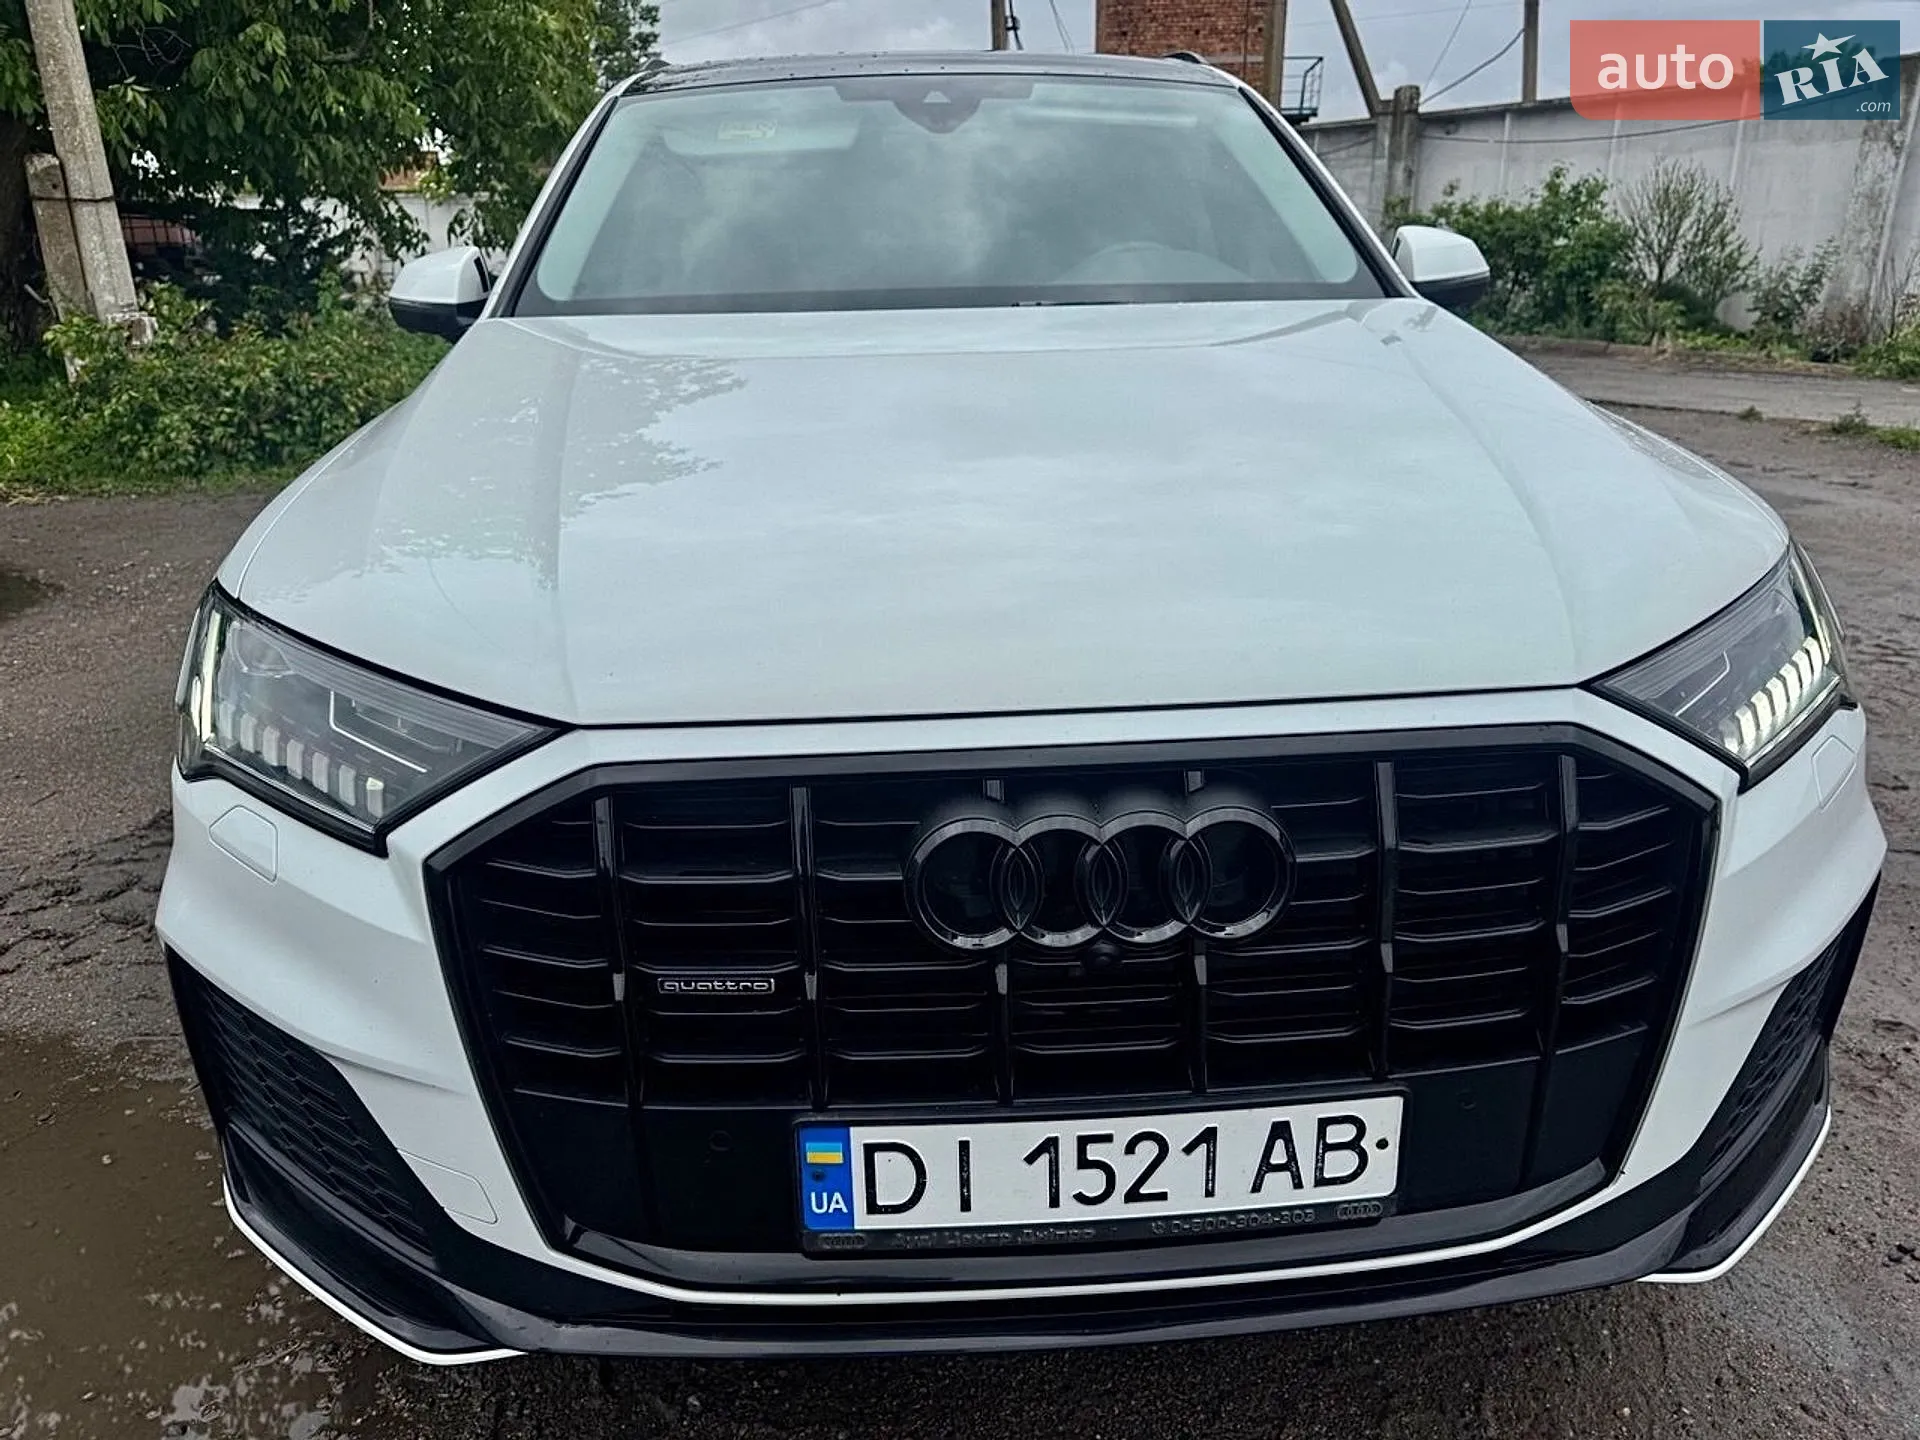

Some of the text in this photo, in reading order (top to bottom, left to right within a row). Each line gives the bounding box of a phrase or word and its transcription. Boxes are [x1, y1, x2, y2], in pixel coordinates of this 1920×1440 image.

[663, 980, 769, 993] quattro
[1023, 1126, 1219, 1209] 1521
[1250, 1114, 1369, 1193] AB
[811, 1192, 848, 1214] UA
